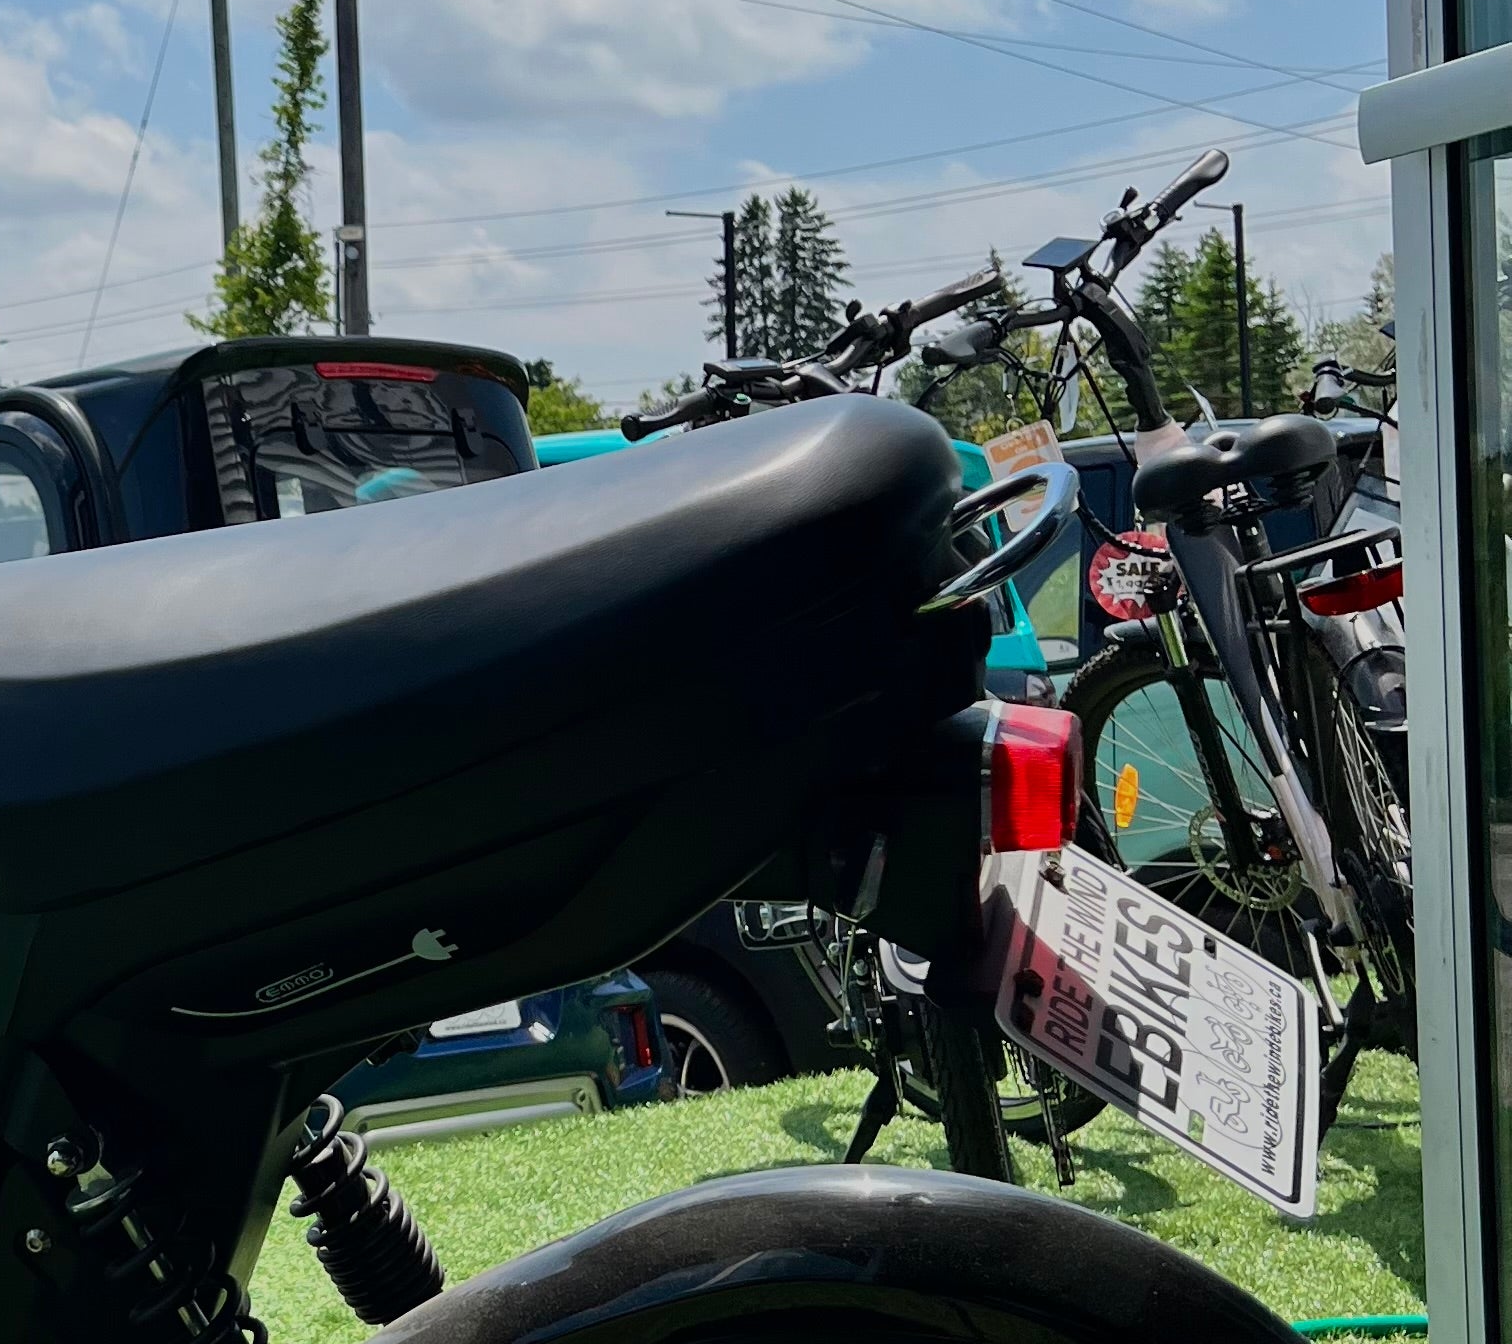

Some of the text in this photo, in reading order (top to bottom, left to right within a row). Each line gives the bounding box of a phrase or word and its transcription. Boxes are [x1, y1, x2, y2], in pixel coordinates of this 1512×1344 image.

[1116, 562, 1161, 577] SALE
[265, 968, 325, 997] EMMO
[1045, 866, 1108, 1056] RIDE THE WIND
[1095, 897, 1194, 1114] EBIKES
[1260, 980, 1283, 1177] www.ridethewindebikes.ca
